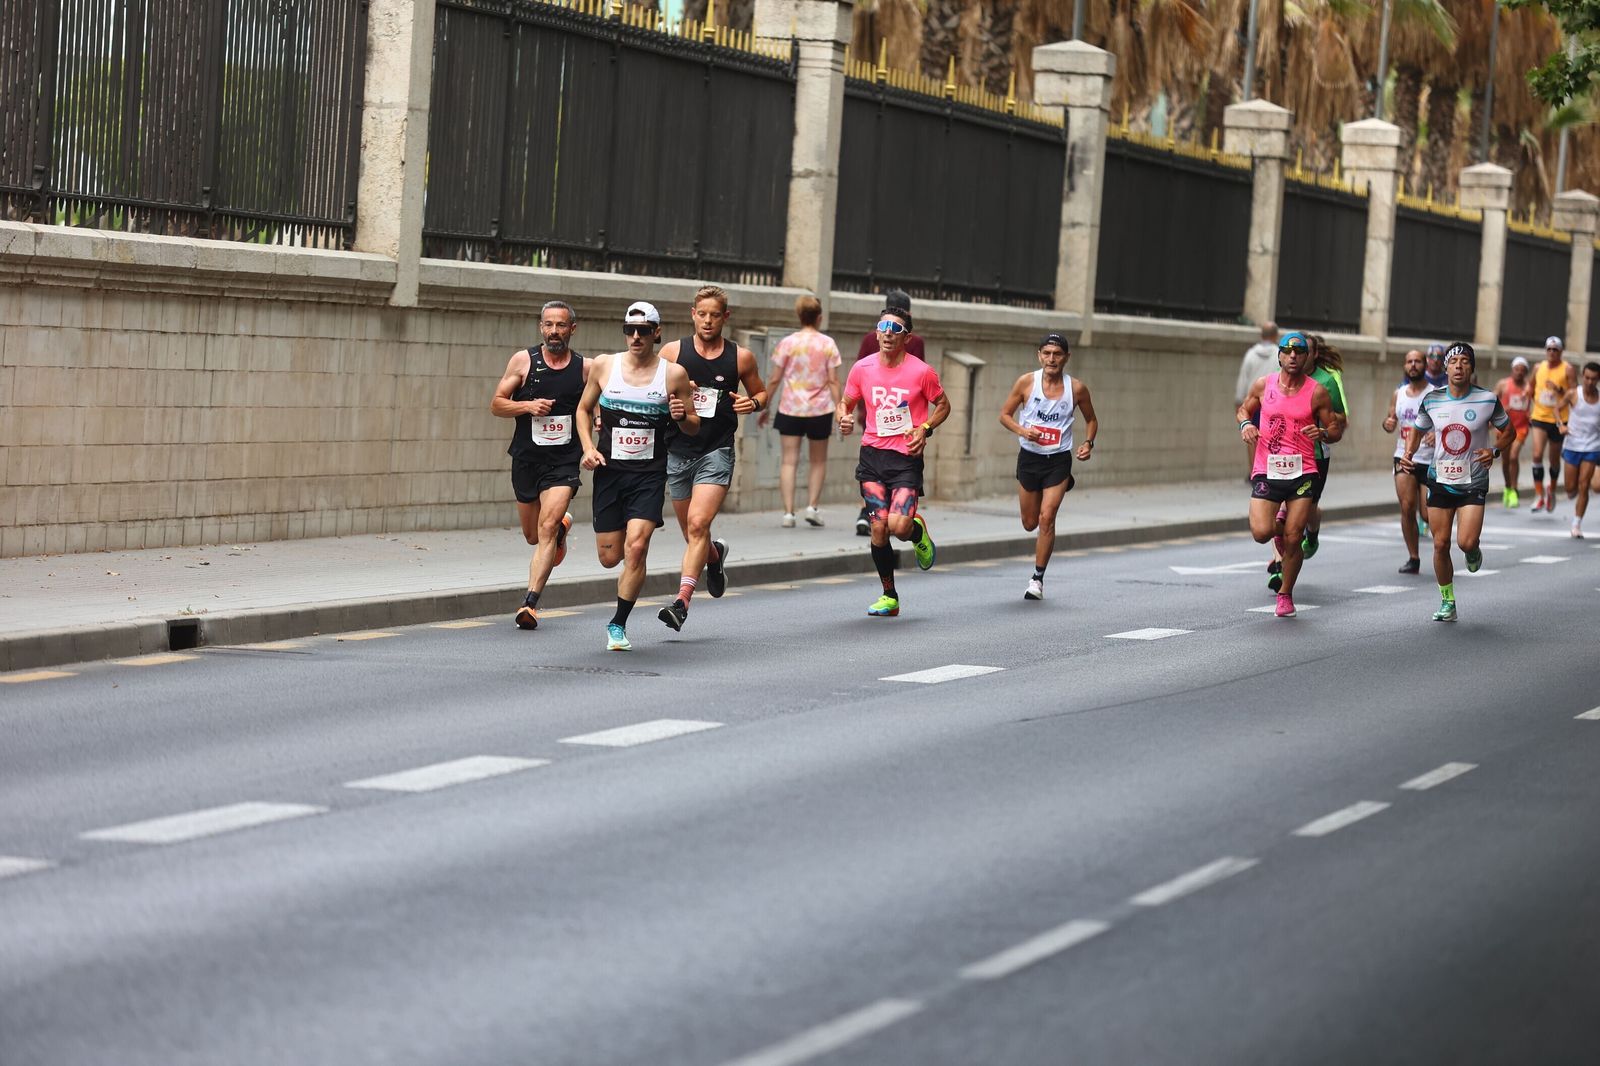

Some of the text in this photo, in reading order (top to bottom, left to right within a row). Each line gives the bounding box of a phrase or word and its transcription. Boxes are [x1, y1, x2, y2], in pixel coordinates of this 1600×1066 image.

[883, 414, 902, 424] 285
[542, 423, 564, 432] 199
[618, 436, 649, 445] 1057
